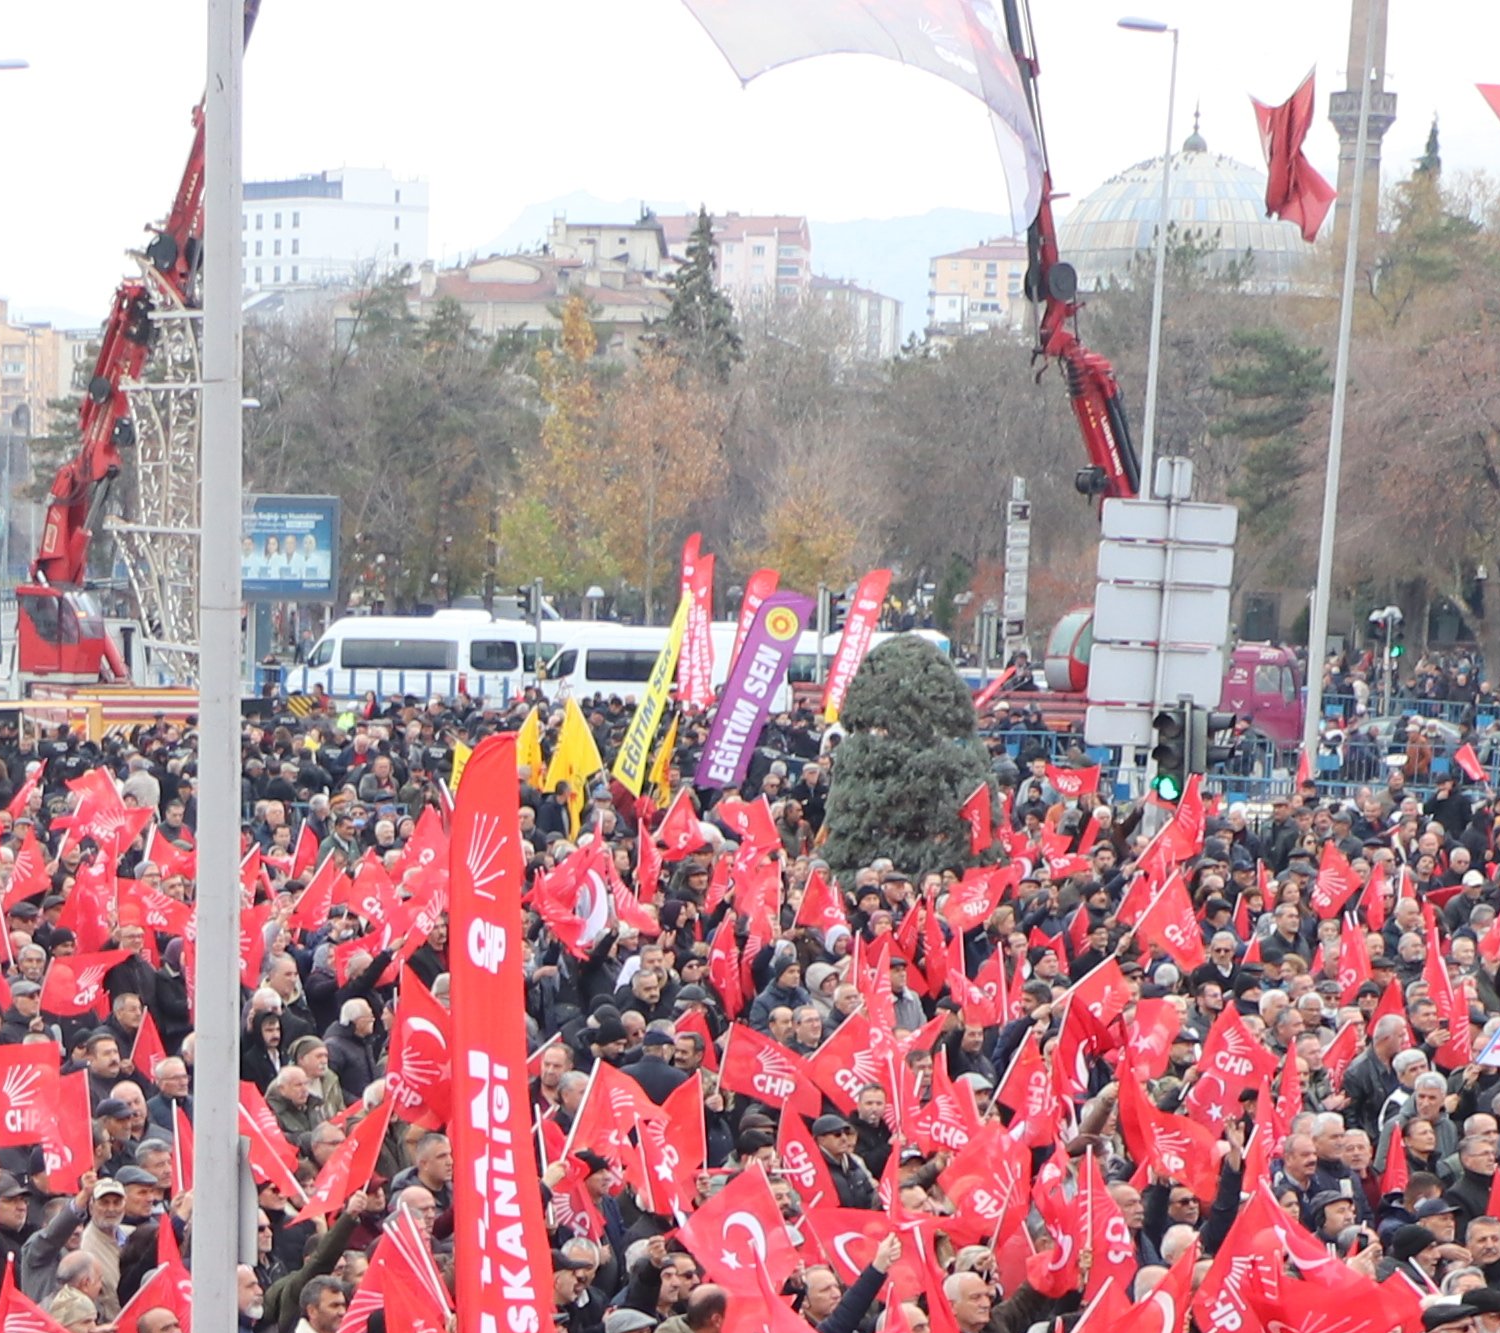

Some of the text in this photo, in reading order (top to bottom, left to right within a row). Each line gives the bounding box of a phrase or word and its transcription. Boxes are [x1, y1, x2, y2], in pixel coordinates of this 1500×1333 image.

[621, 647, 673, 781] EĞİTİM SEN
[708, 643, 782, 783] EĞİTİM SEN
[469, 919, 505, 970] CHP
[1165, 925, 1184, 944] CH
[74, 987, 96, 1005] CH
[1216, 1053, 1253, 1074] CHP
[387, 1074, 421, 1109] CHP
[755, 1074, 793, 1097] CHP
[835, 1071, 864, 1098] CH
[6, 1109, 40, 1131] CHP
[930, 1121, 967, 1148] CHP
[1208, 1298, 1242, 1332] HP
